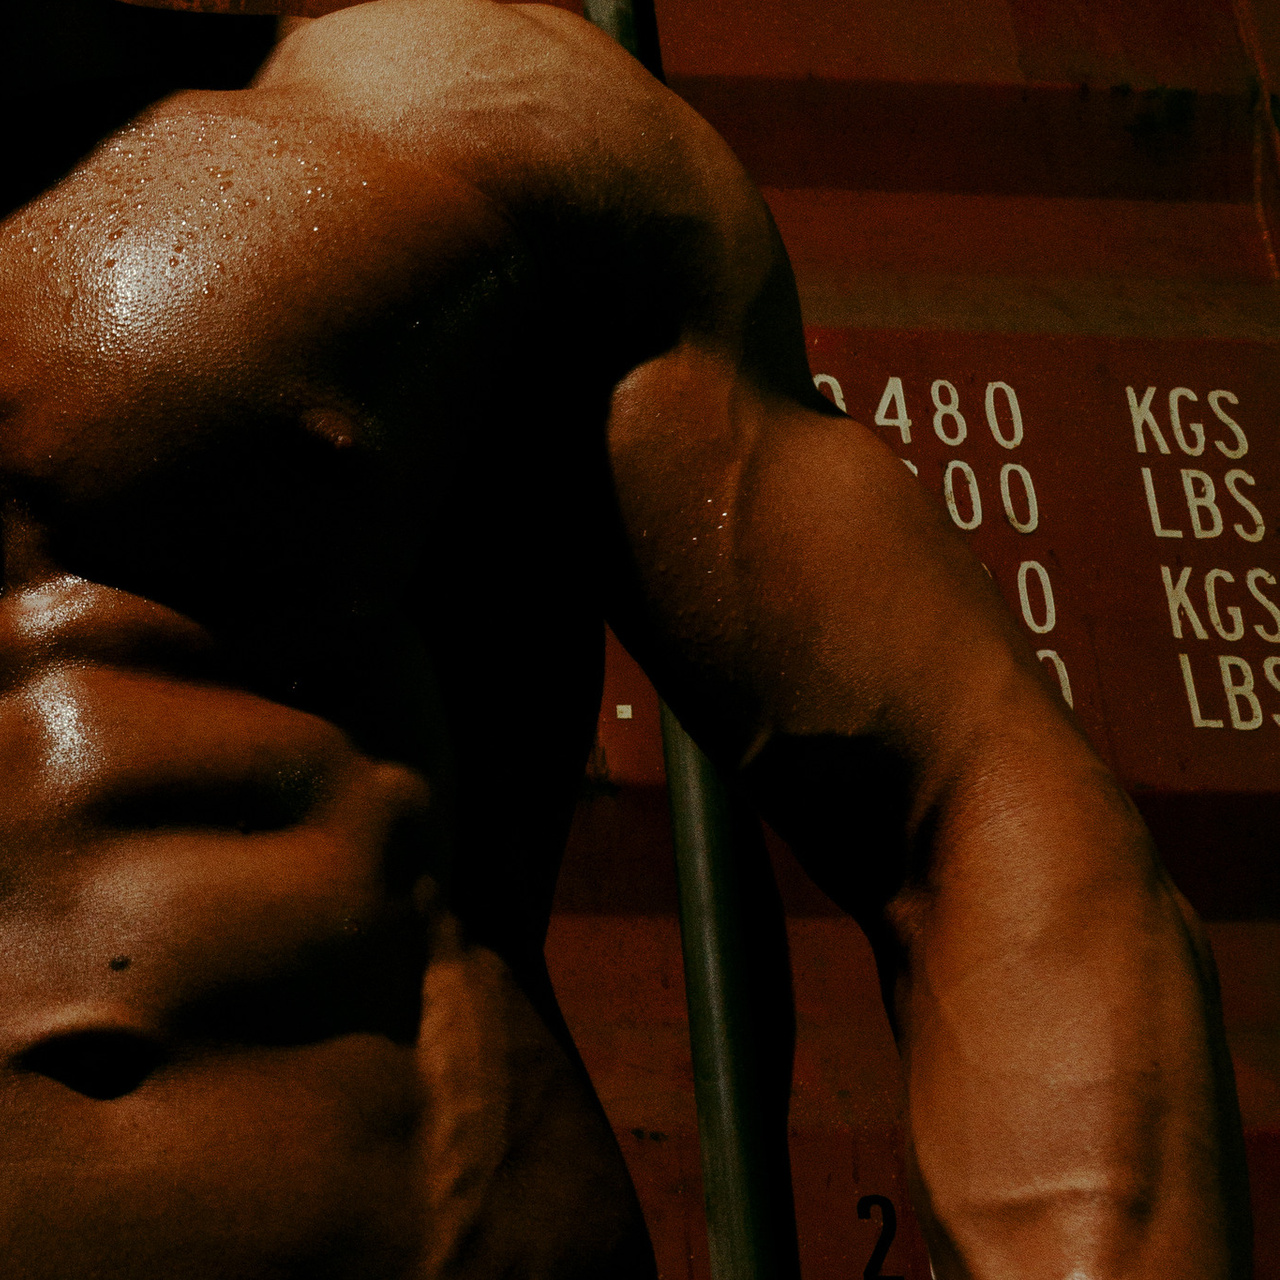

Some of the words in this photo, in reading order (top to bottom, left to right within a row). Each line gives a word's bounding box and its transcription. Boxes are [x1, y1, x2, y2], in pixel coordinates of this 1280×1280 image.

[1125, 385, 1250, 460] KGS
[900, 458, 1039, 535] 00
[1140, 466, 1266, 543] LBS
[1160, 564, 1280, 644] KGS
